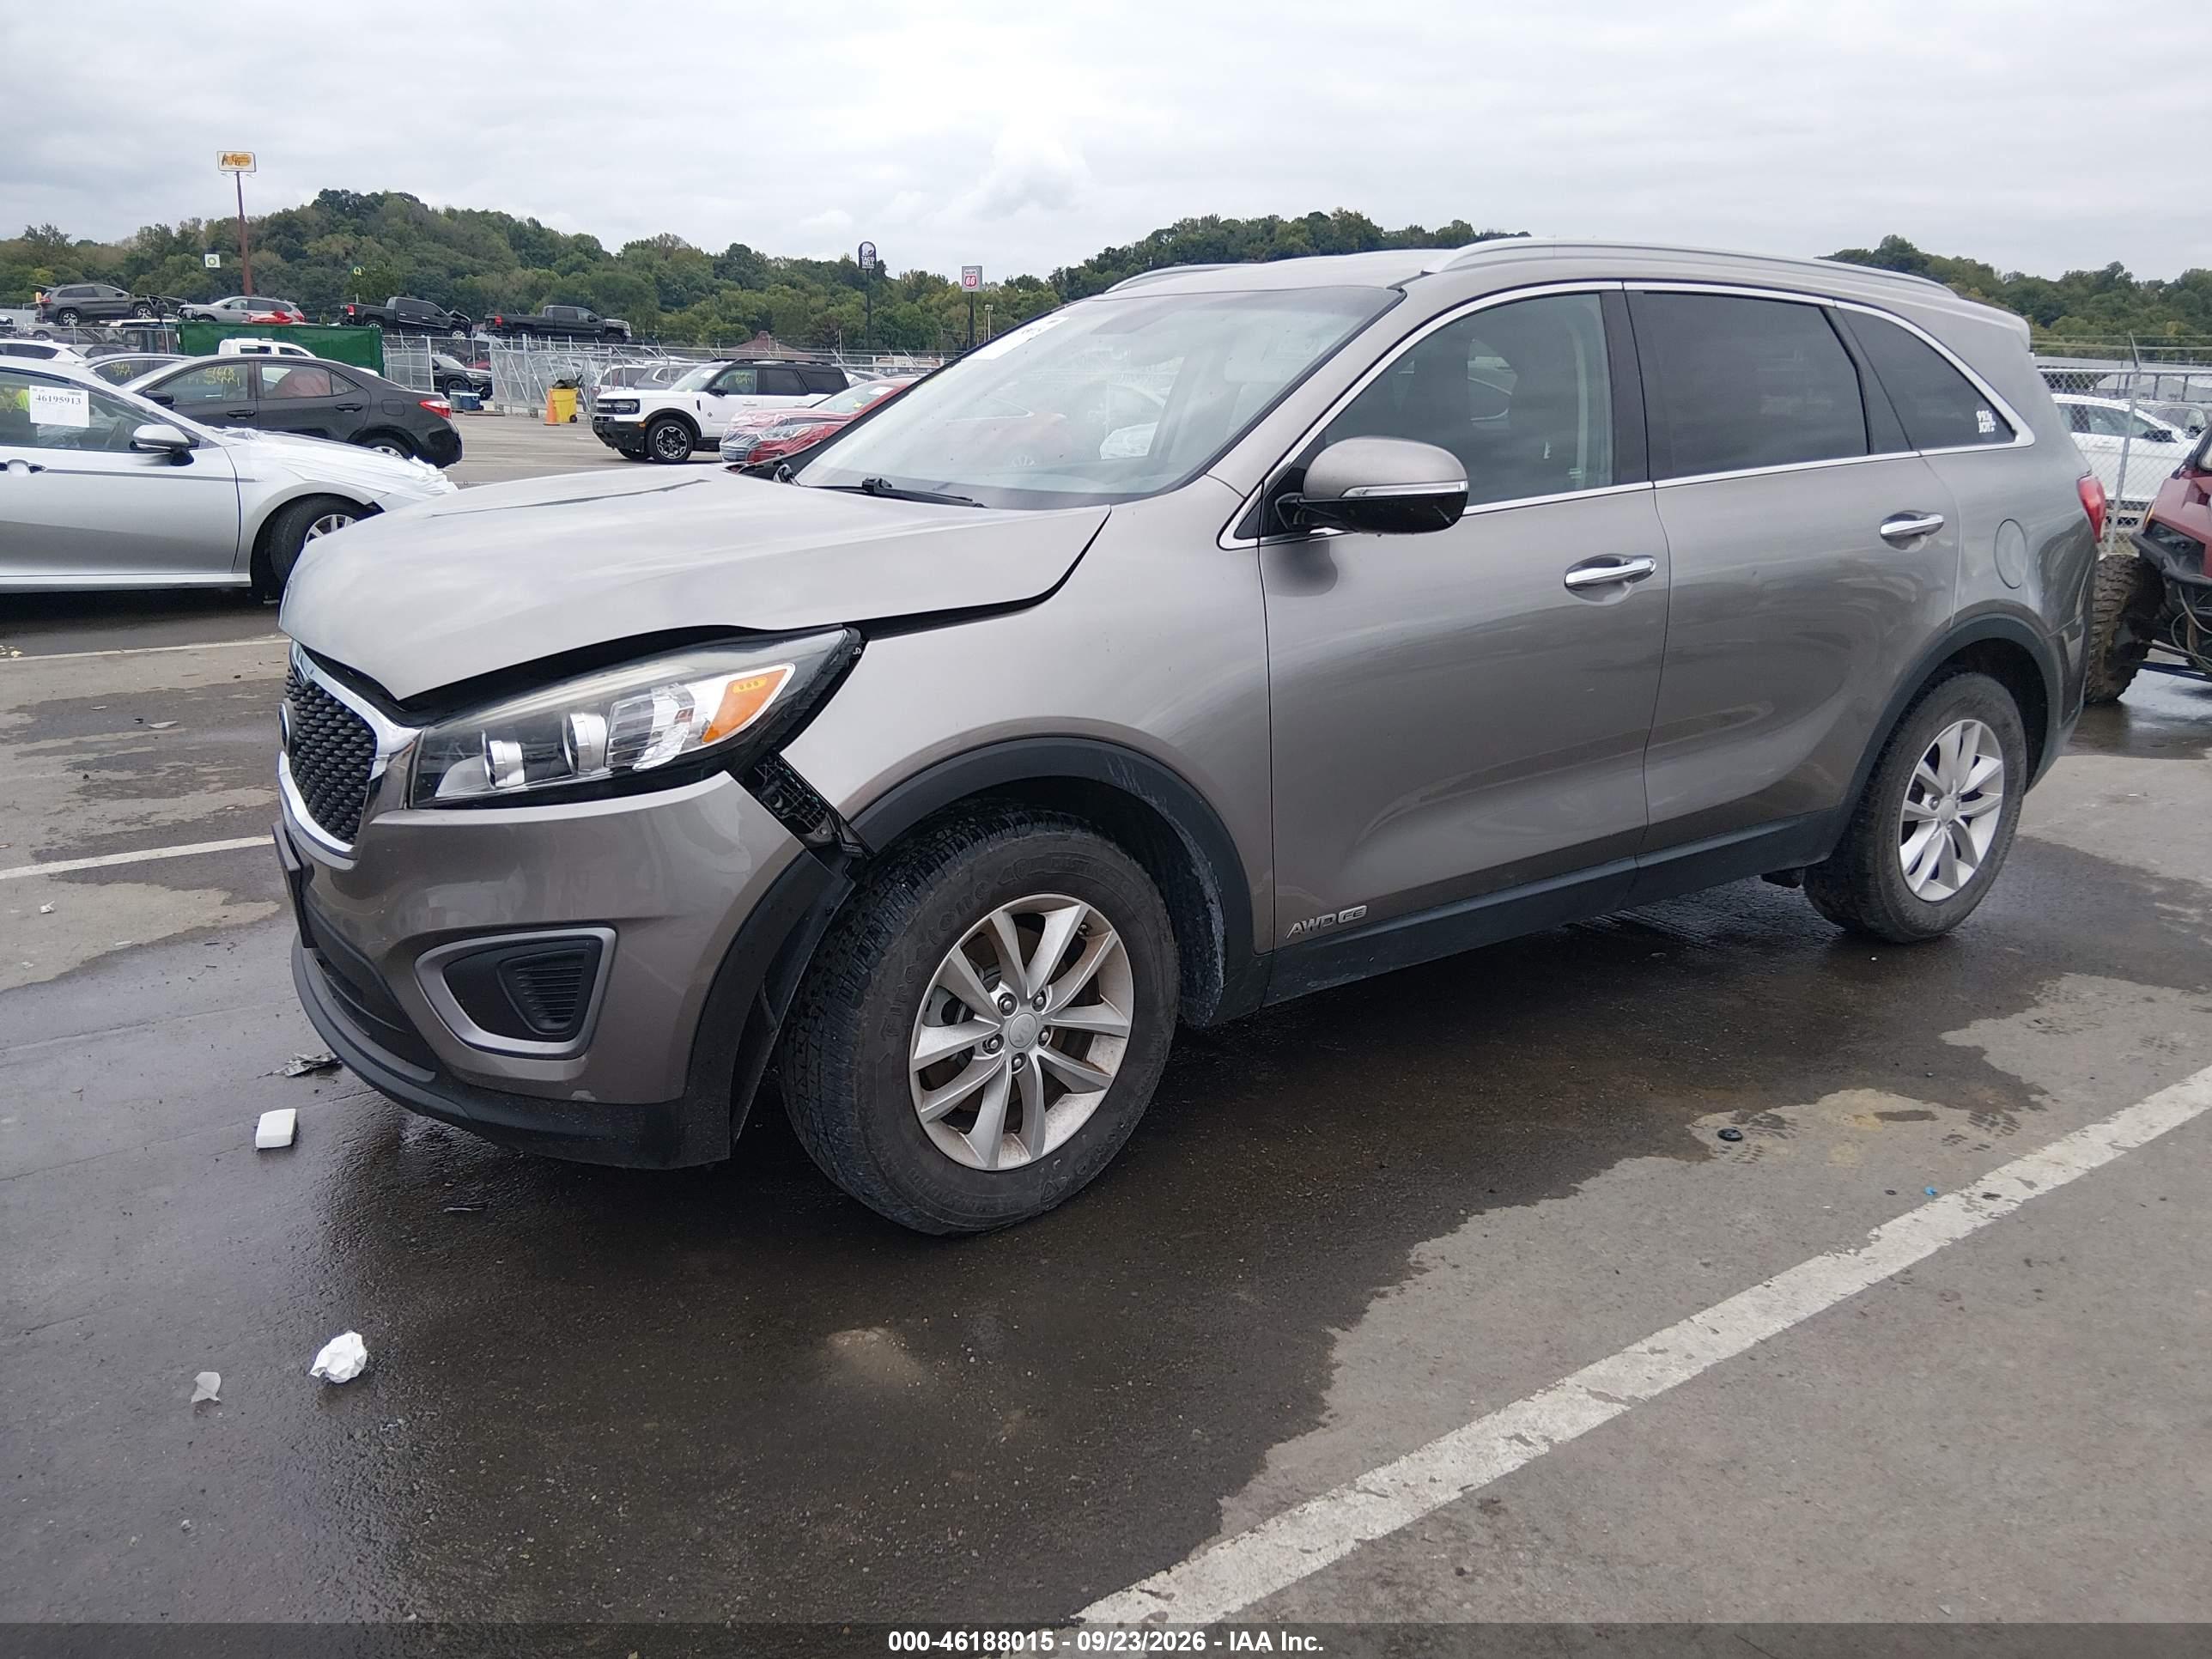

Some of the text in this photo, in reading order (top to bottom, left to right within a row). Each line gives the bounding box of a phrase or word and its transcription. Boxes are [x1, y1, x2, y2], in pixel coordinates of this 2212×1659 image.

[965, 276, 975, 285] 66
[35, 393, 82, 405] 46195913
[1285, 913, 1336, 939] AWD
